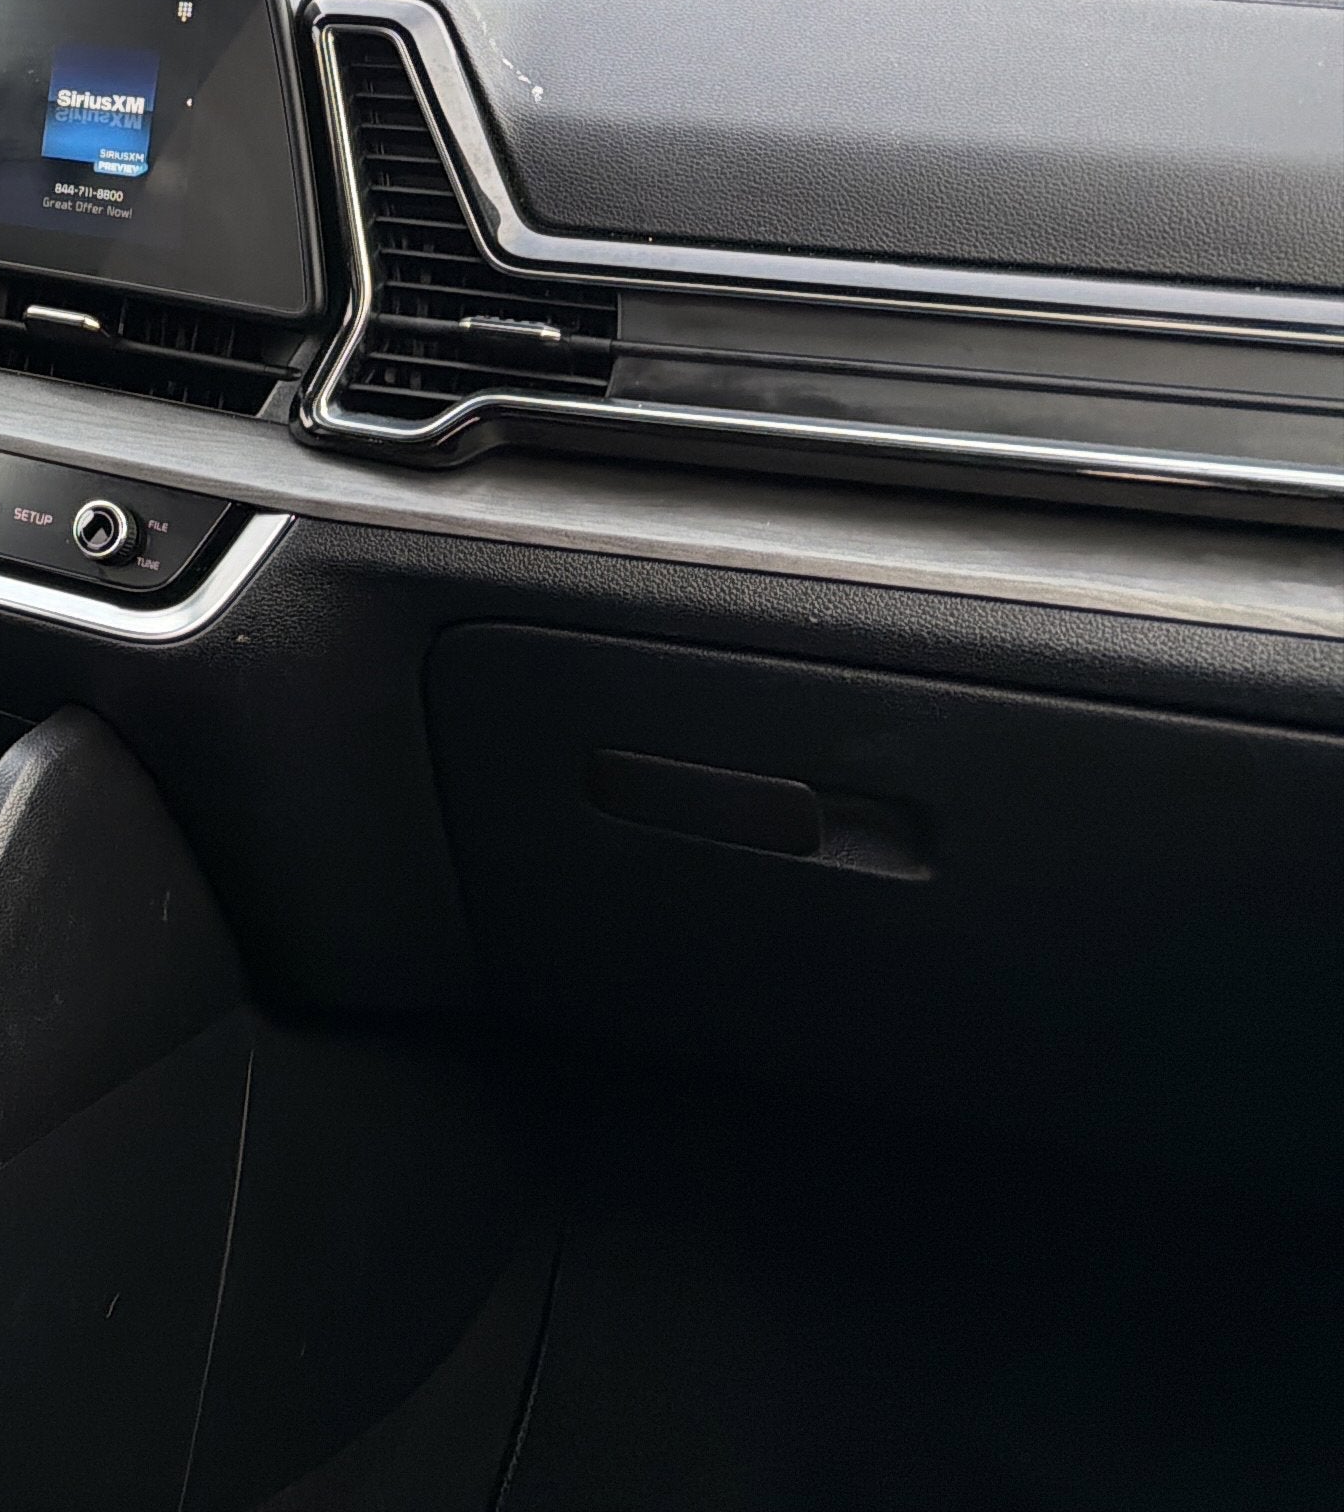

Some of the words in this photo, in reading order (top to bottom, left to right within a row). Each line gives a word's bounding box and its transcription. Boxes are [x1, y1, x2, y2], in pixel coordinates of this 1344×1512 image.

[56, 89, 145, 115] SiriusXM
[99, 148, 145, 163] SIRIUSXM
[54, 182, 124, 203] 844-711-8800
[42, 197, 73, 212] Great
[75, 200, 104, 216] Offer
[106, 205, 133, 219] Now!
[14, 507, 54, 527] SETUP
[148, 519, 169, 533] FILE
[136, 556, 161, 572] TUNE
